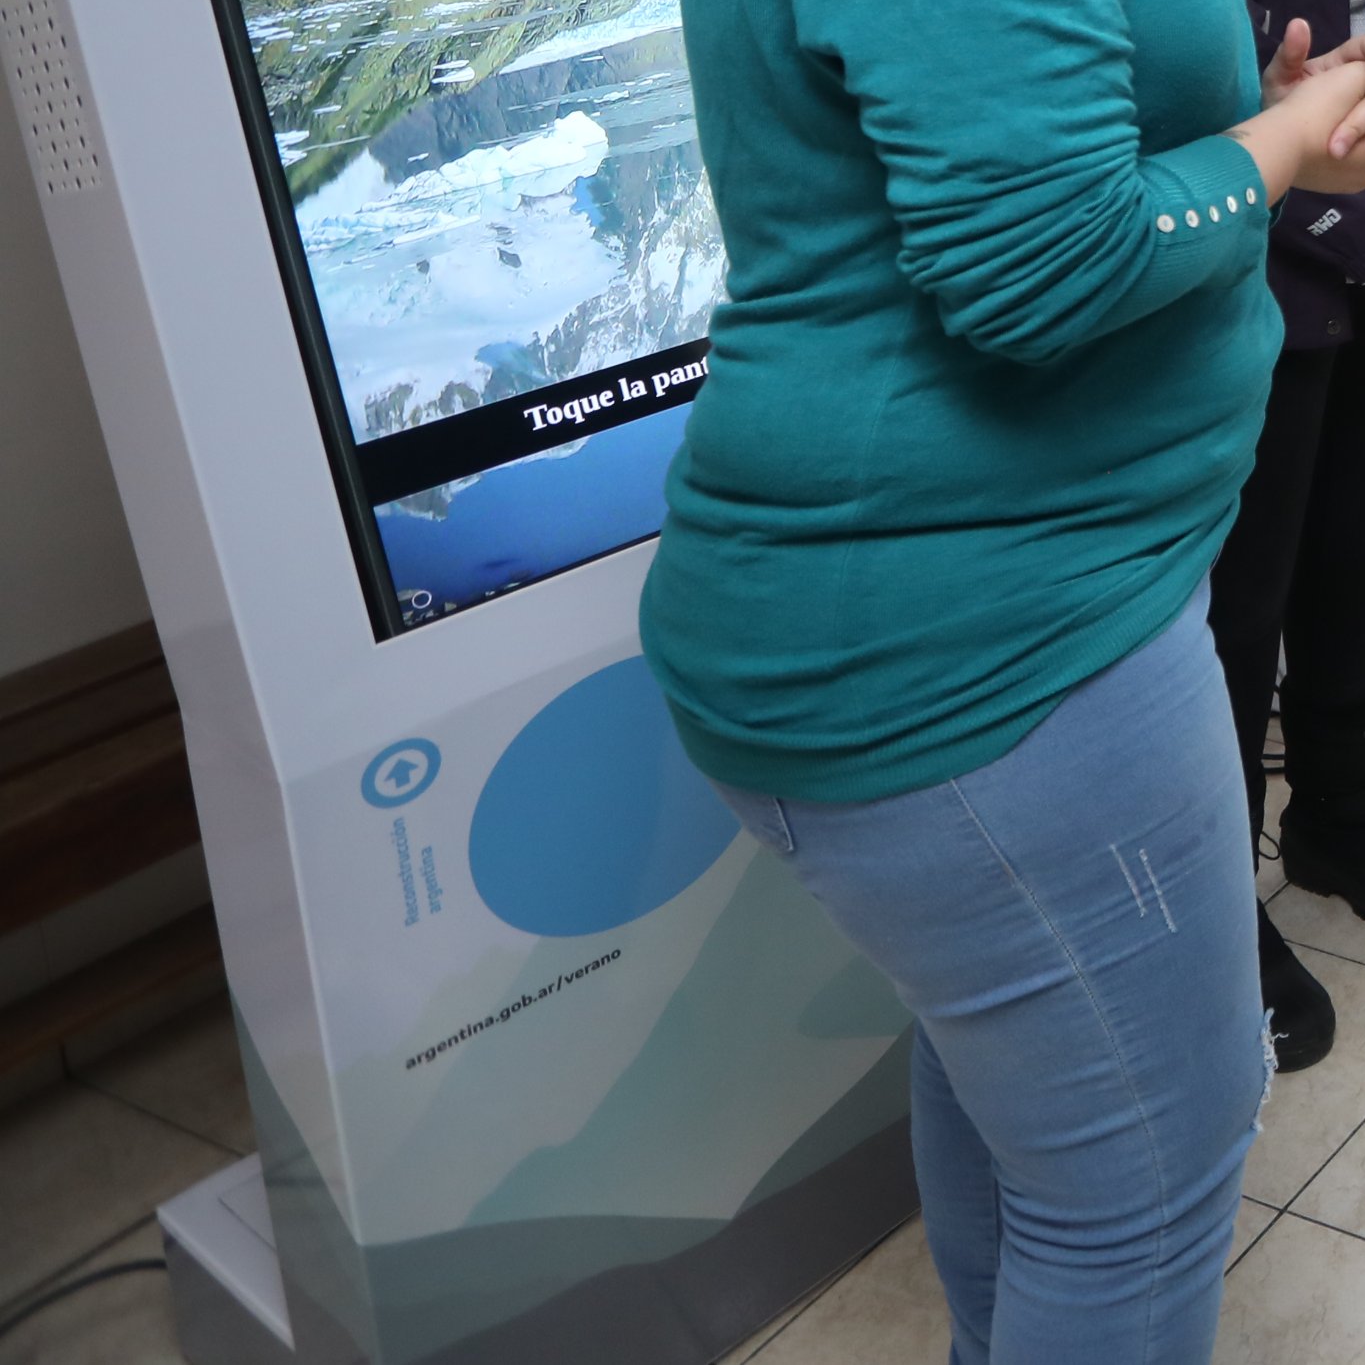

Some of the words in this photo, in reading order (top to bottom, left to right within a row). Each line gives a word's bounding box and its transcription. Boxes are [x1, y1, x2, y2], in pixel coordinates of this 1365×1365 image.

[523, 389, 615, 431] Toque
[618, 377, 648, 402] la
[651, 356, 709, 397] pant
[420, 844, 443, 914] argentina
[405, 948, 622, 1070] argentina.gob.ar/verano
